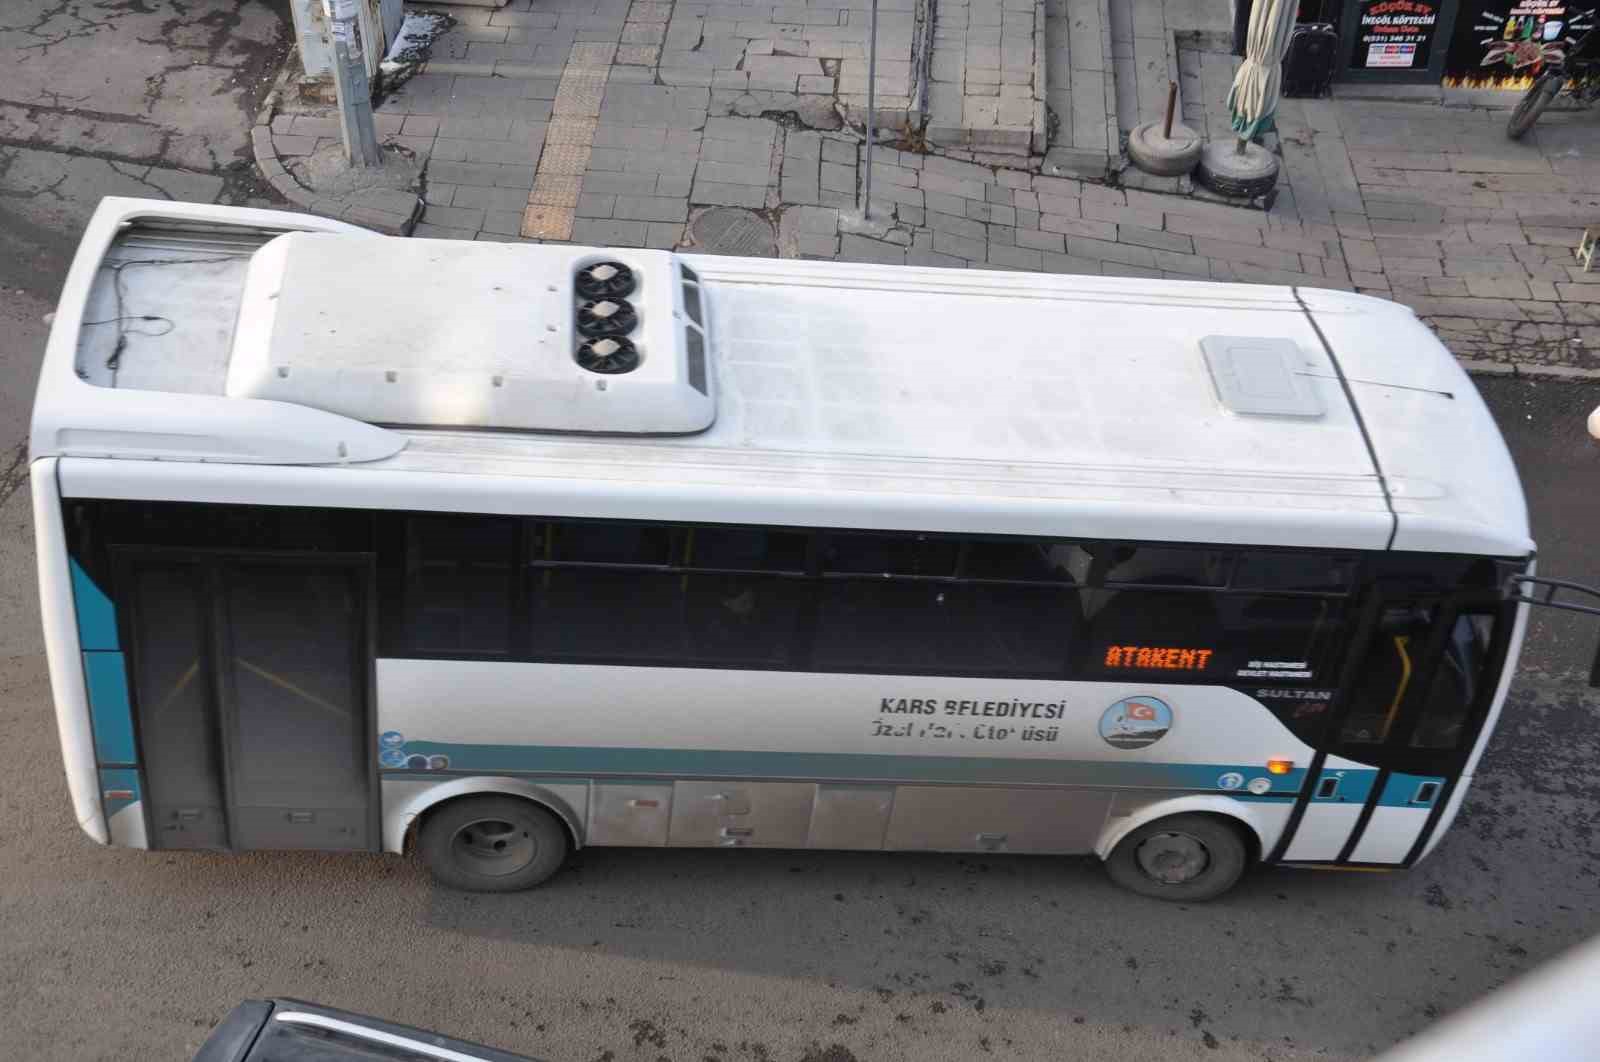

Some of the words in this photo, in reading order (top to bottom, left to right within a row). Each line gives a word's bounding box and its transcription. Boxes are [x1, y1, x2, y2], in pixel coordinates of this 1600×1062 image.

[1362, 14, 1391, 24] İNEGÖL
[1105, 645, 1213, 670] ATAKENT
[1256, 688, 1332, 700] SULTAN
[880, 697, 938, 715] KARS
